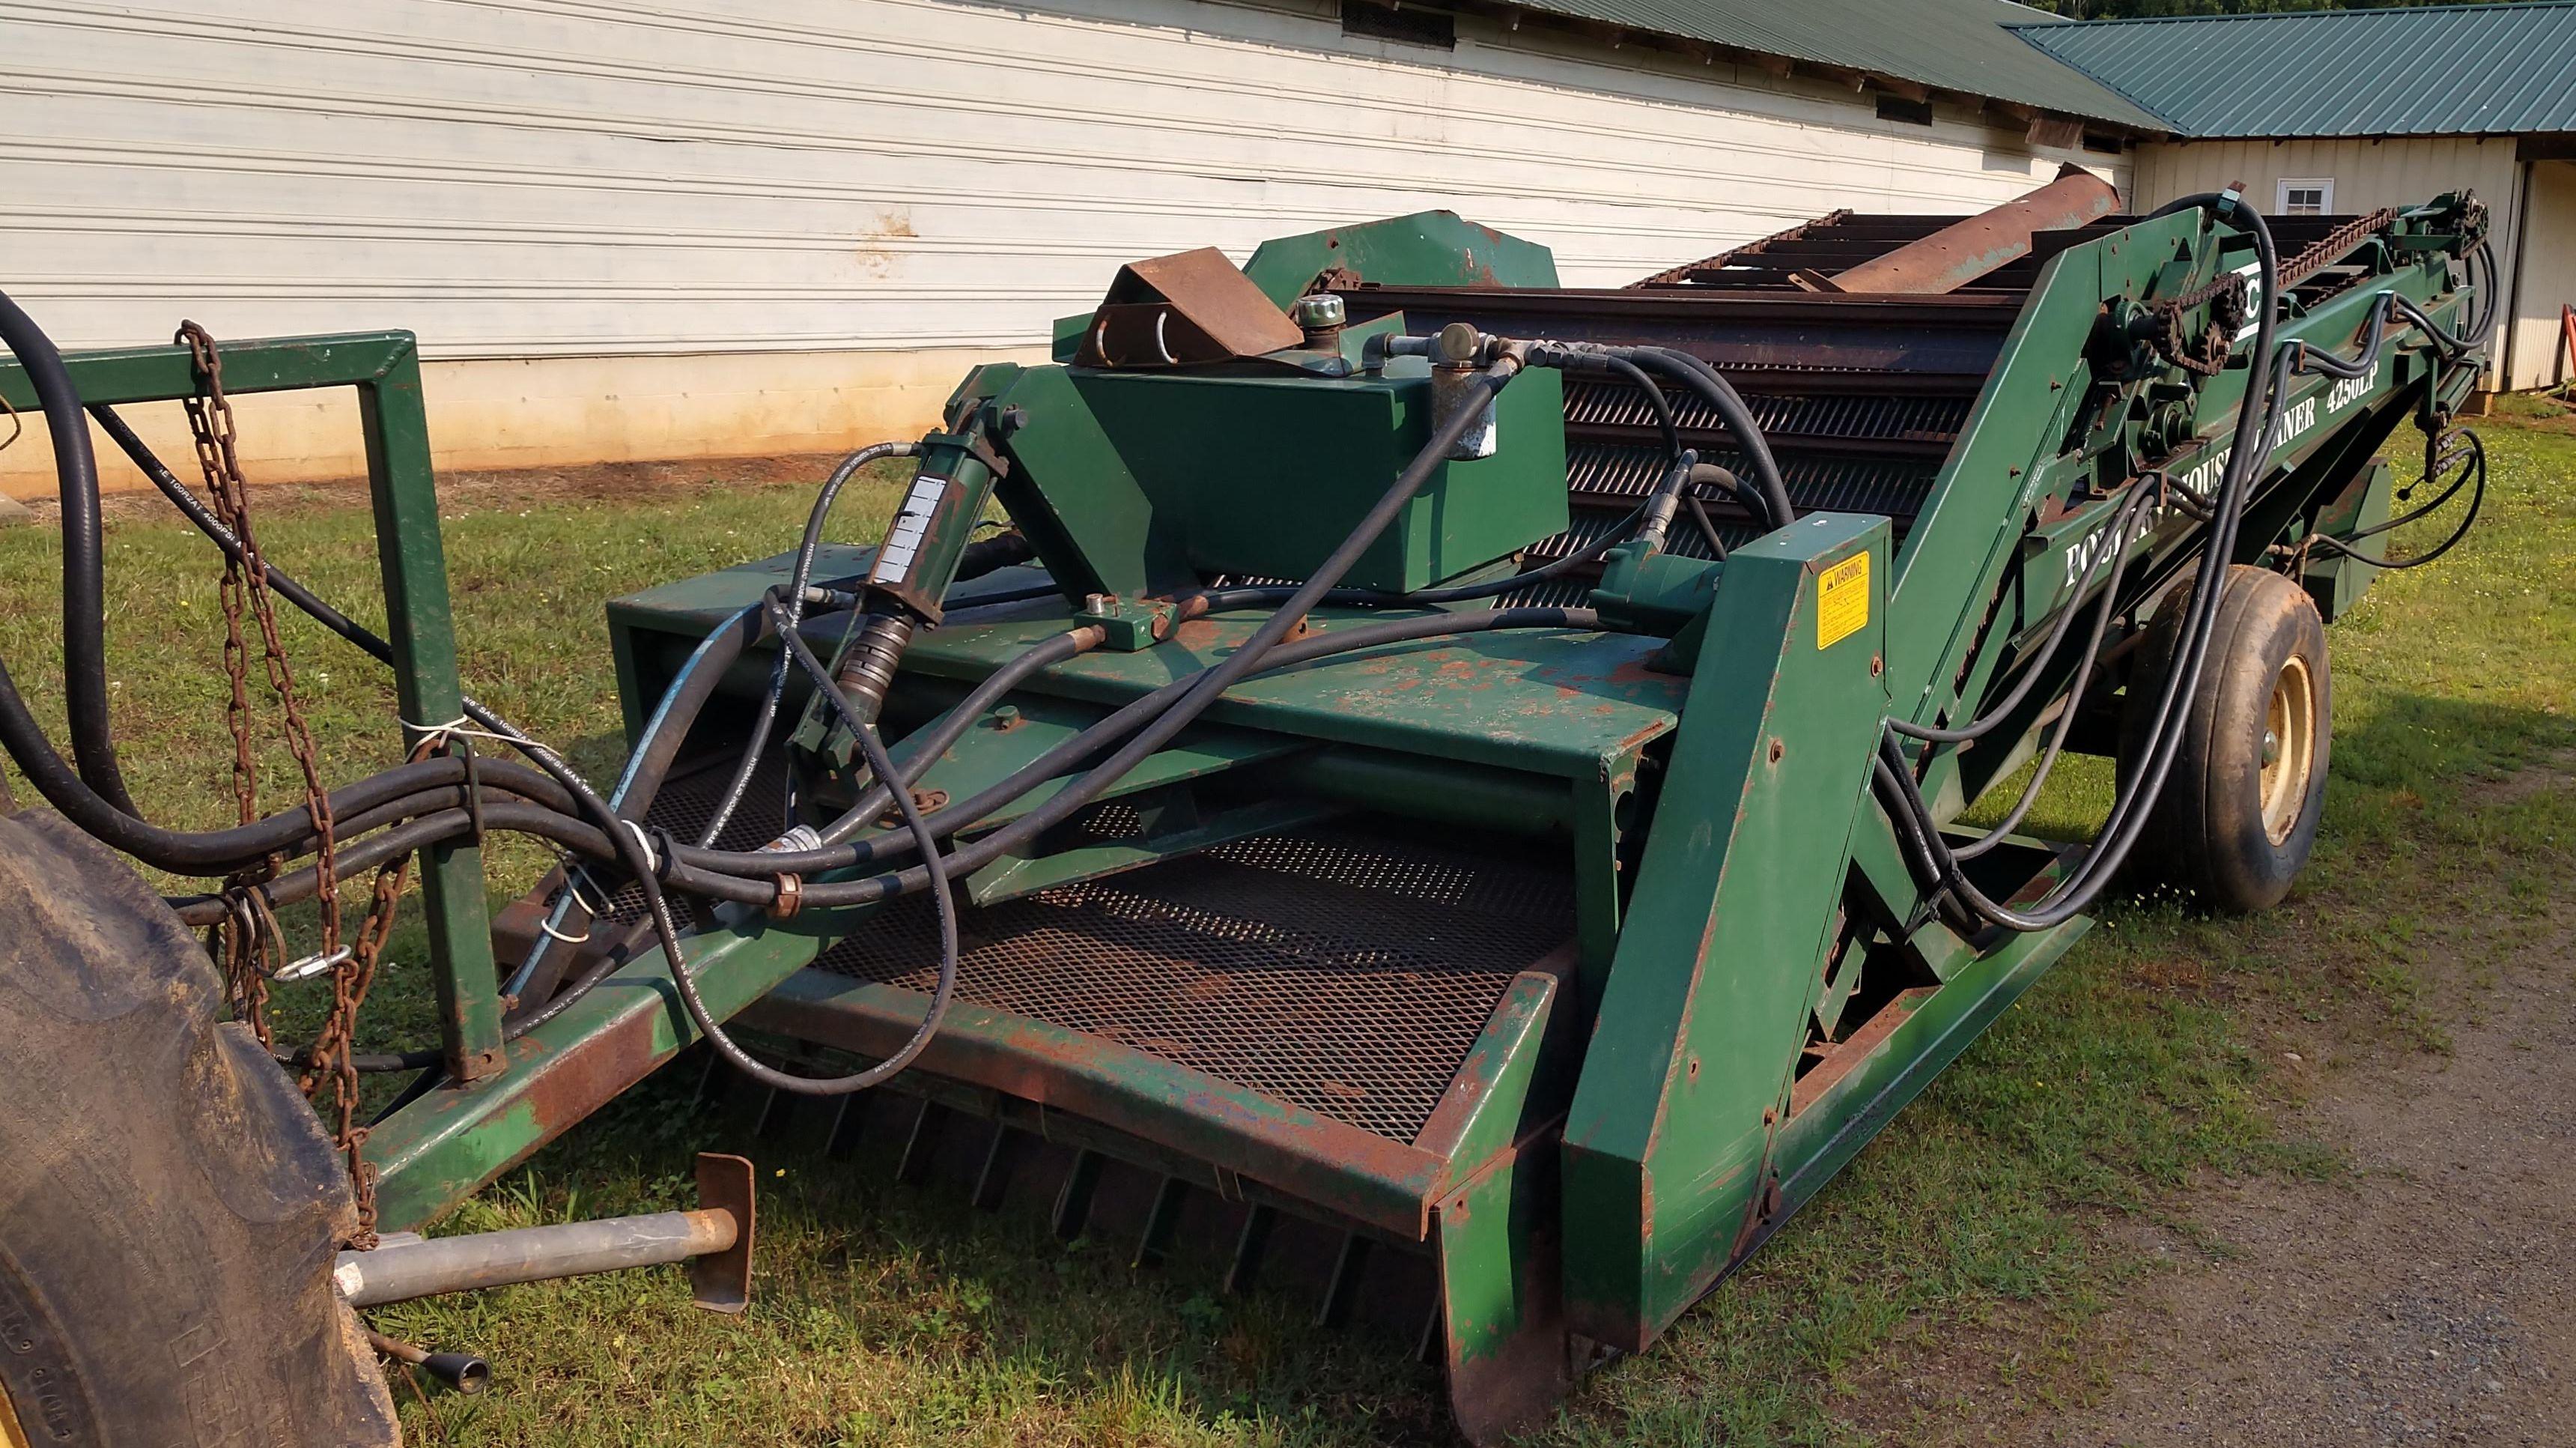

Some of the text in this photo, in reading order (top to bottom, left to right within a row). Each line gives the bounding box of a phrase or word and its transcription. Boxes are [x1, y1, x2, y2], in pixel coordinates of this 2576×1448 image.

[153, 459, 170, 478] SAE
[169, 479, 203, 511] 100R2AT
[204, 512, 235, 541] 4000PSI
[801, 542, 815, 580] HYDRAULIC
[1834, 559, 1862, 587] WARNING
[796, 579, 807, 599] HOSE
[479, 706, 499, 721] SAE
[534, 747, 564, 769] 000PSI
[563, 768, 581, 785] MAX
[580, 783, 595, 796] WP
[735, 757, 758, 796] HYDRAULIC
[723, 796, 739, 817] HOSE
[657, 895, 676, 939] HYDRAULIC
[672, 940, 684, 963] HOSE
[685, 977, 697, 996] SAE
[693, 994, 714, 1025] 100R2AT
[711, 1024, 735, 1052] 4000PSI
[734, 1047, 750, 1064] MAX
